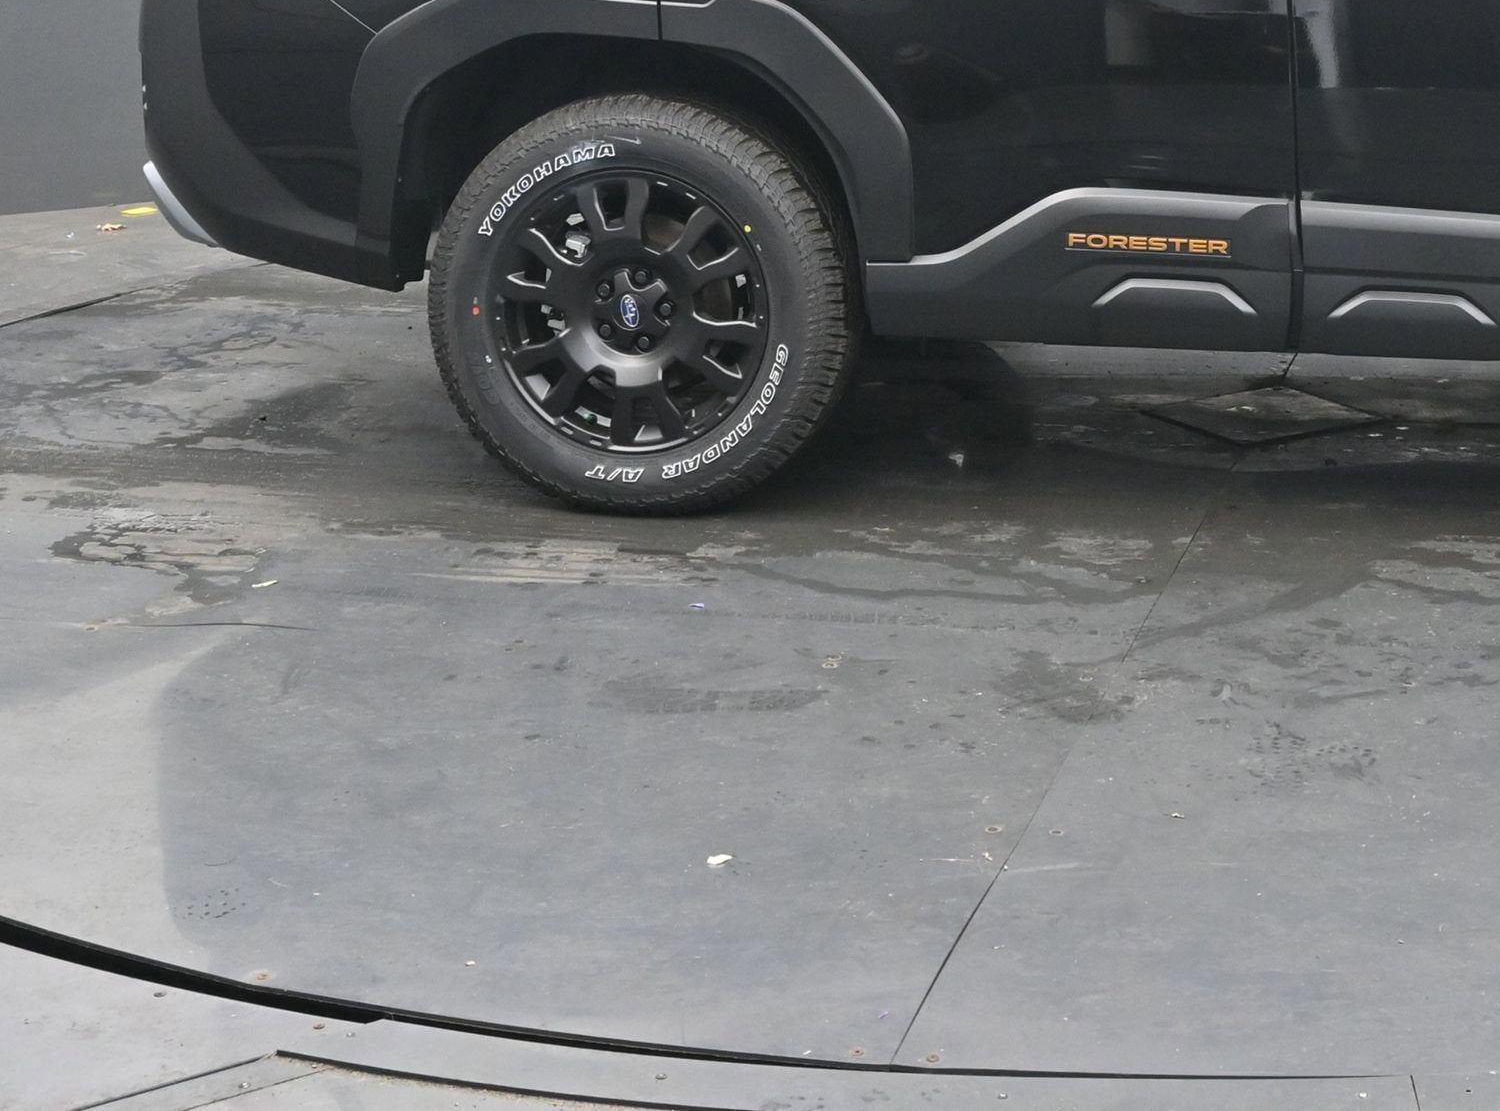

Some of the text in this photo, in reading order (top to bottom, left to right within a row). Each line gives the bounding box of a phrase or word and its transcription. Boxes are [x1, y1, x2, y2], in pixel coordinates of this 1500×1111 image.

[478, 143, 615, 236] YOKOHAMA
[1068, 233, 1228, 254] FORESTER
[585, 344, 789, 482] GEOLANDAR A/T
